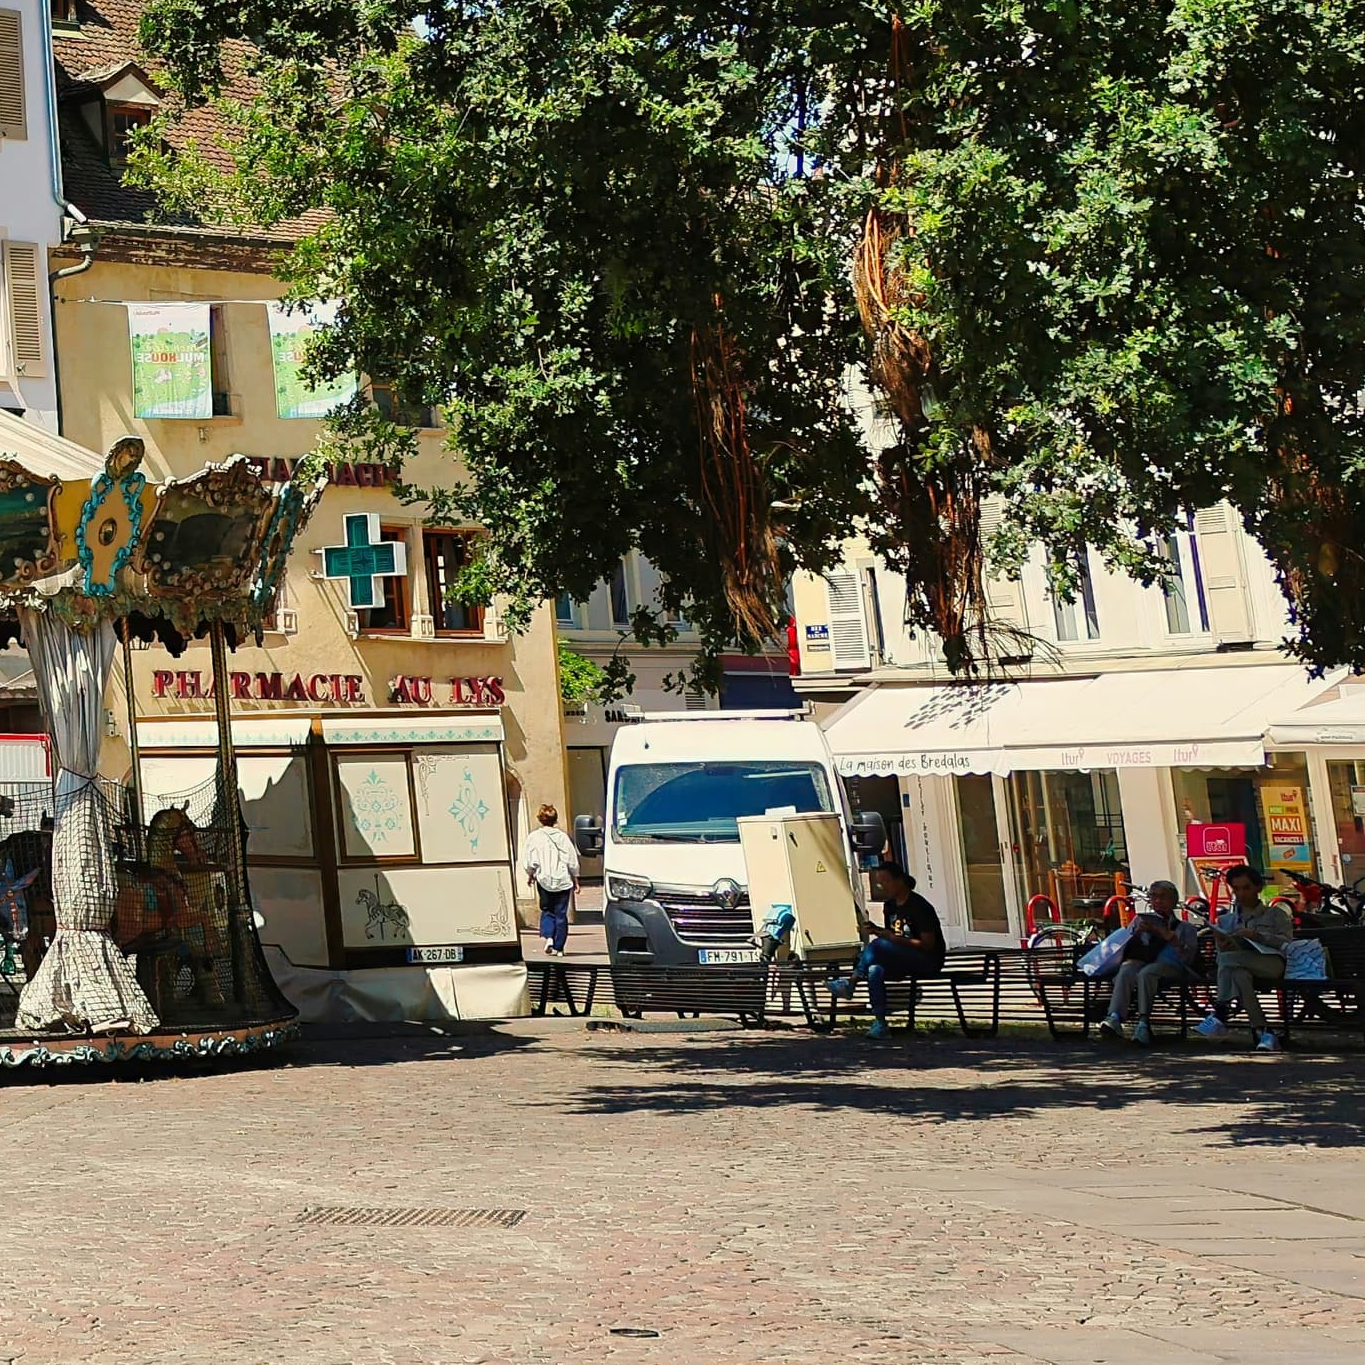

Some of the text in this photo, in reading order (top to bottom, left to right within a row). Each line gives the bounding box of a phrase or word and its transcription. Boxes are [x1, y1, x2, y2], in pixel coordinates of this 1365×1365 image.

[390, 674, 432, 704] AU
[449, 676, 506, 705] LYS
[839, 753, 971, 771] La maison des Bredalas
[1107, 751, 1151, 764] VOYAGES
[1271, 817, 1301, 831] MAXI
